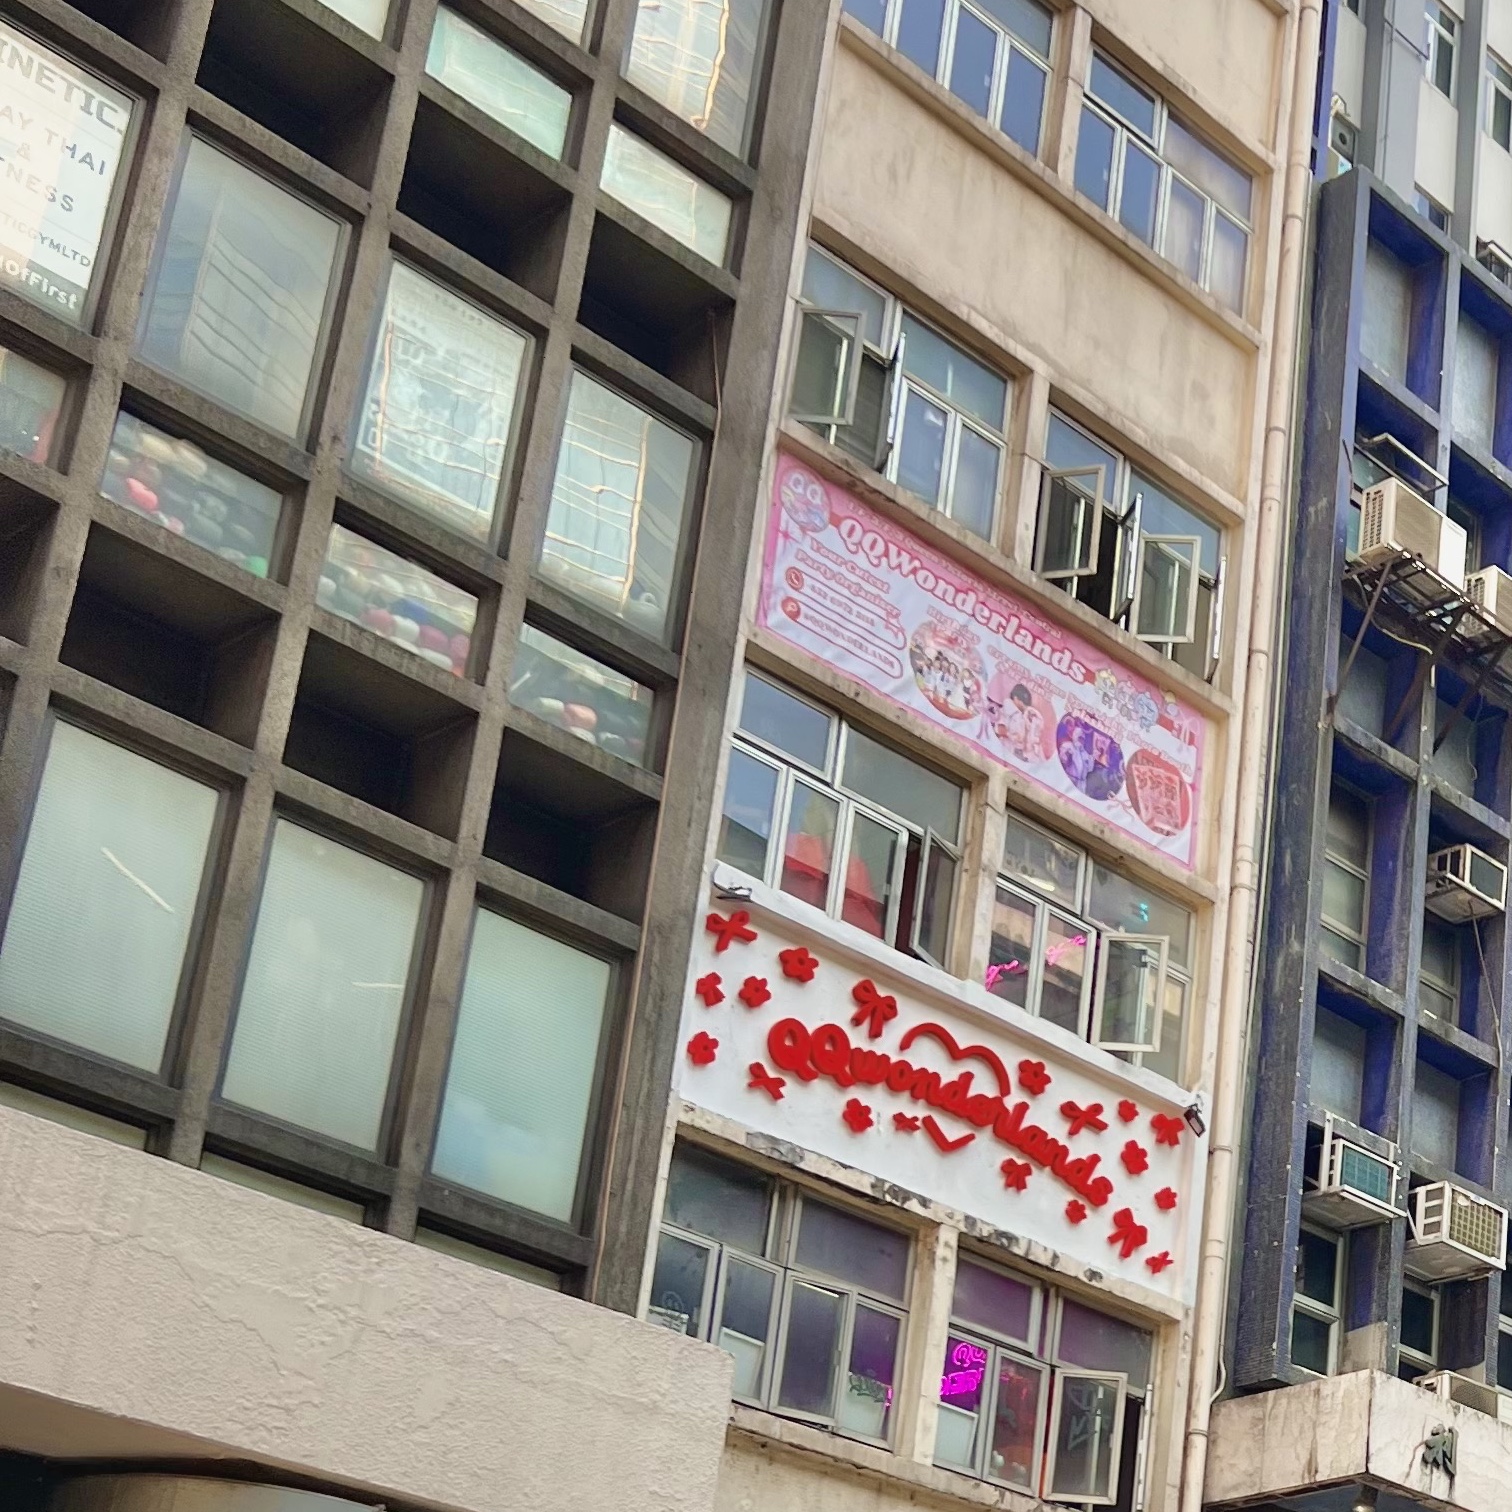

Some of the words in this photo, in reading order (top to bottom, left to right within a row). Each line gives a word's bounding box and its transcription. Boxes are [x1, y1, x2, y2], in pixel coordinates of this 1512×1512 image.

[45, 127, 106, 175] THAI
[0, 156, 74, 212] NESS
[0, 256, 77, 309] OfFirst
[795, 547, 834, 582] Party
[810, 536, 845, 568] Your
[846, 558, 890, 595] Cutest
[837, 516, 1086, 685] QQWonderlands
